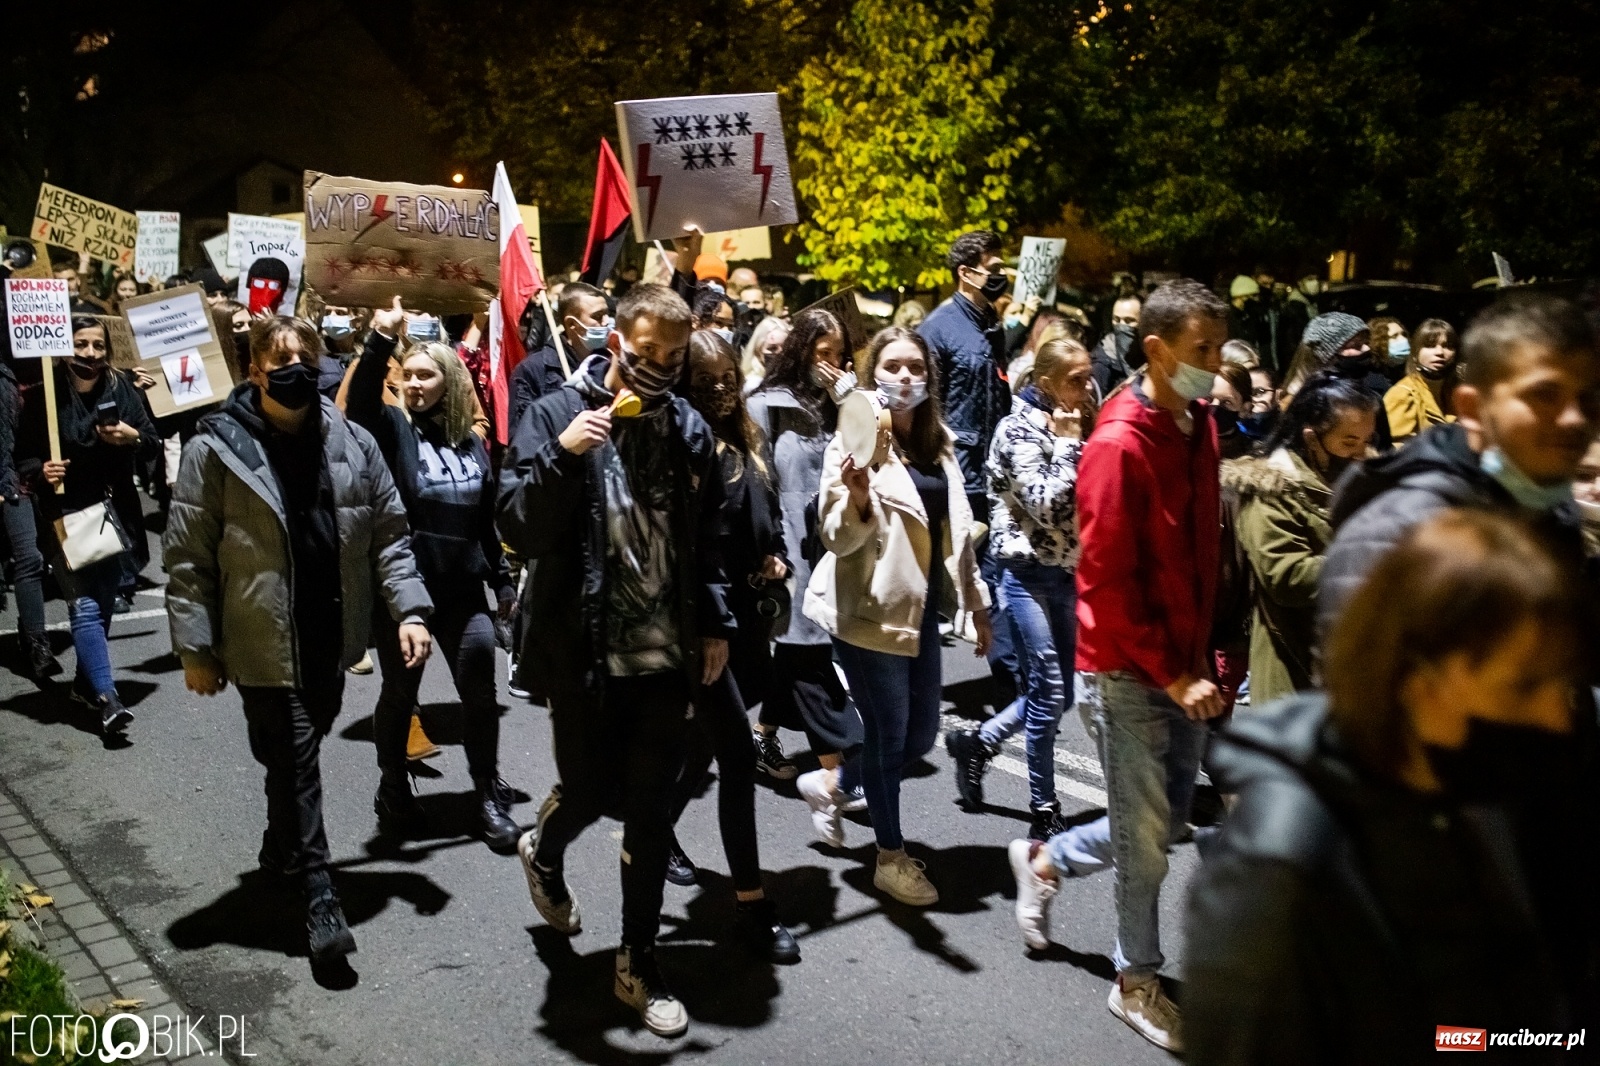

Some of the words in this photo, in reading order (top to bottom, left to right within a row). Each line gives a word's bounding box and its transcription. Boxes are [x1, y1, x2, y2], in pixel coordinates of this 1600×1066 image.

[41, 187, 116, 225] MEFEDRON
[121, 216, 137, 234] MA
[37, 203, 90, 233] LEPSZY
[95, 223, 136, 249] SKŁAD
[1034, 240, 1054, 257] NIE
[11, 292, 50, 304] KOCHAM
[12, 302, 65, 313] ROZUMIEM
[14, 324, 65, 340] ODDAĆ
[16, 340, 32, 351] NIE
[38, 339, 71, 351] UMIEM
